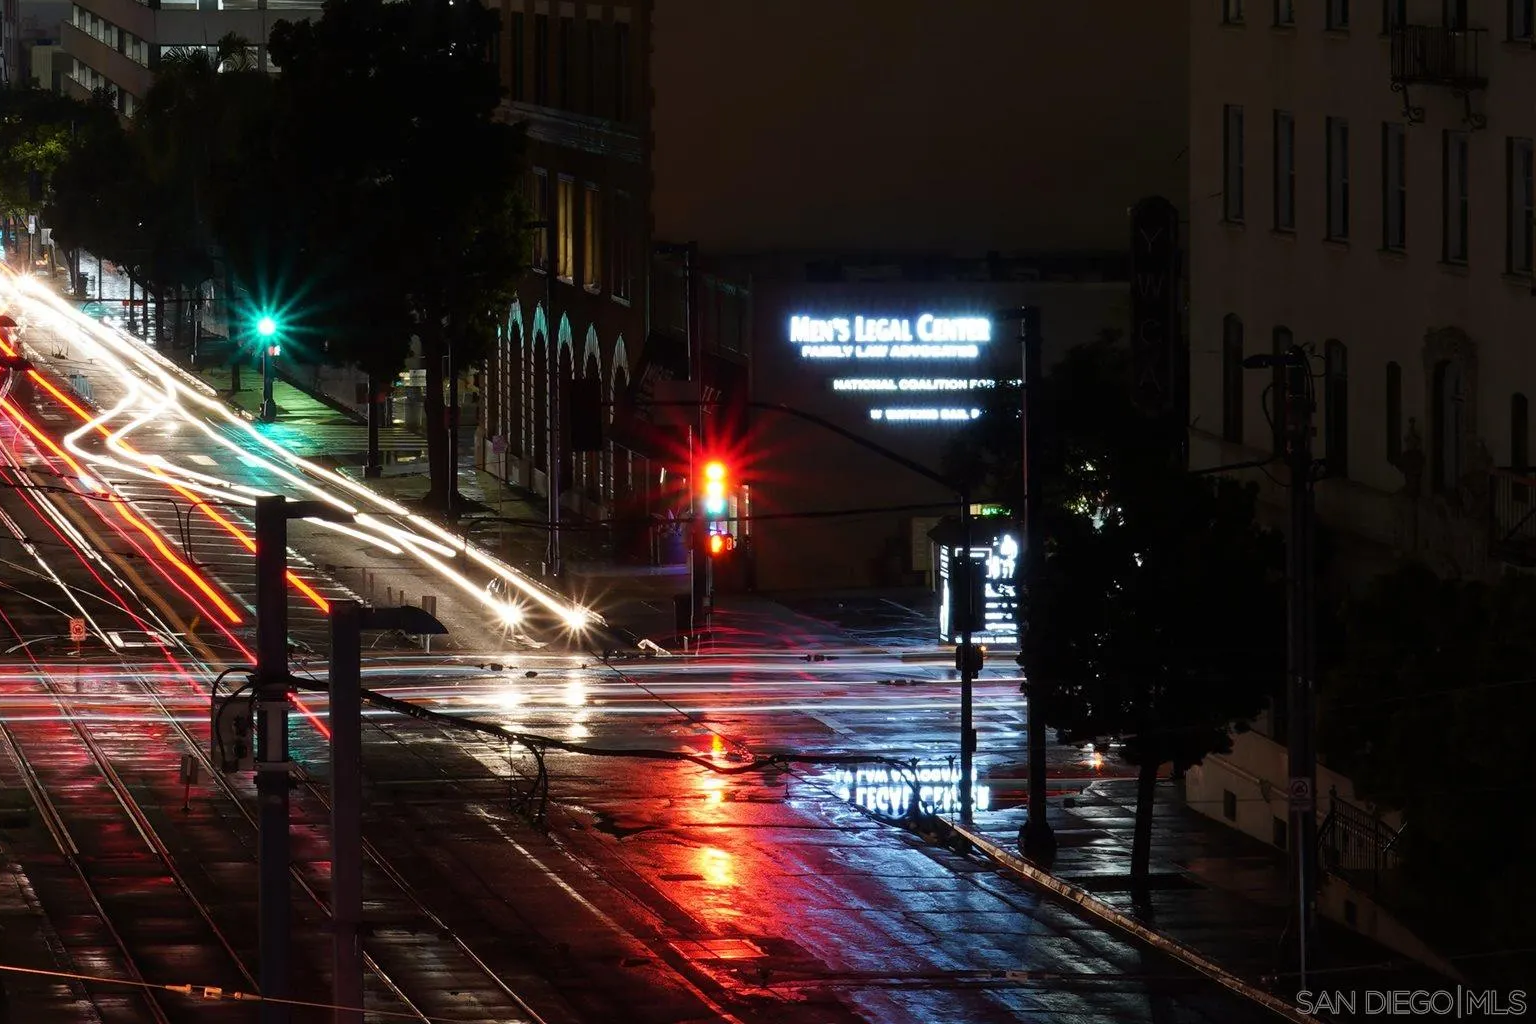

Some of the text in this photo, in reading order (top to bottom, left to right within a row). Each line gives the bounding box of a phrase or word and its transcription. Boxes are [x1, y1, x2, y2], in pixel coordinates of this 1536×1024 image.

[1137, 225, 1164, 396] YWCA
[855, 346, 889, 357] LAW
[833, 379, 897, 390] NATIONAL
[899, 379, 967, 390] COALITION
